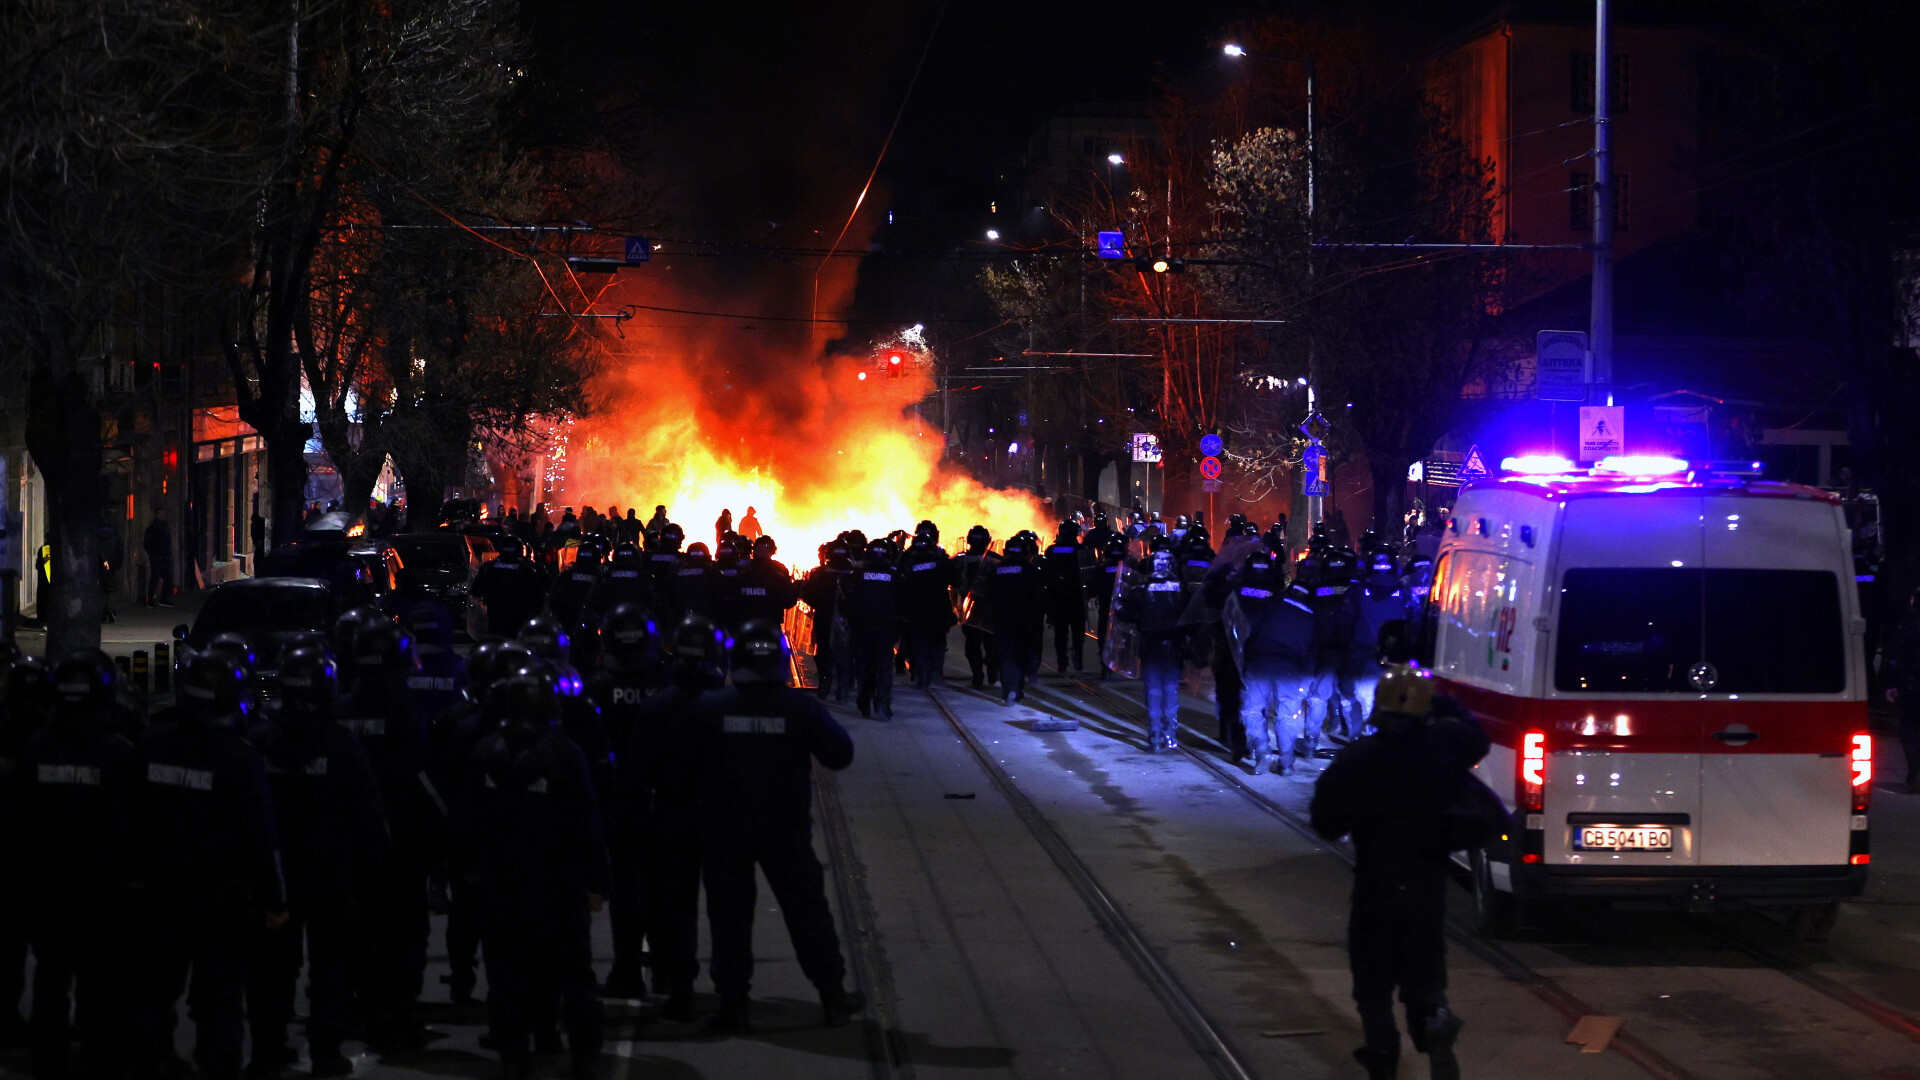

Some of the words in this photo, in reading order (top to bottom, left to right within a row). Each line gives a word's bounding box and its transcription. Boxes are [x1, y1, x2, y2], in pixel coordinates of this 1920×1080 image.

[1542, 358, 1583, 367] АПТЕКА
[741, 587, 767, 597] POLICE
[1496, 606, 1517, 653] 112
[1584, 830, 1604, 846] CB
[1607, 831, 1645, 847] 5041
